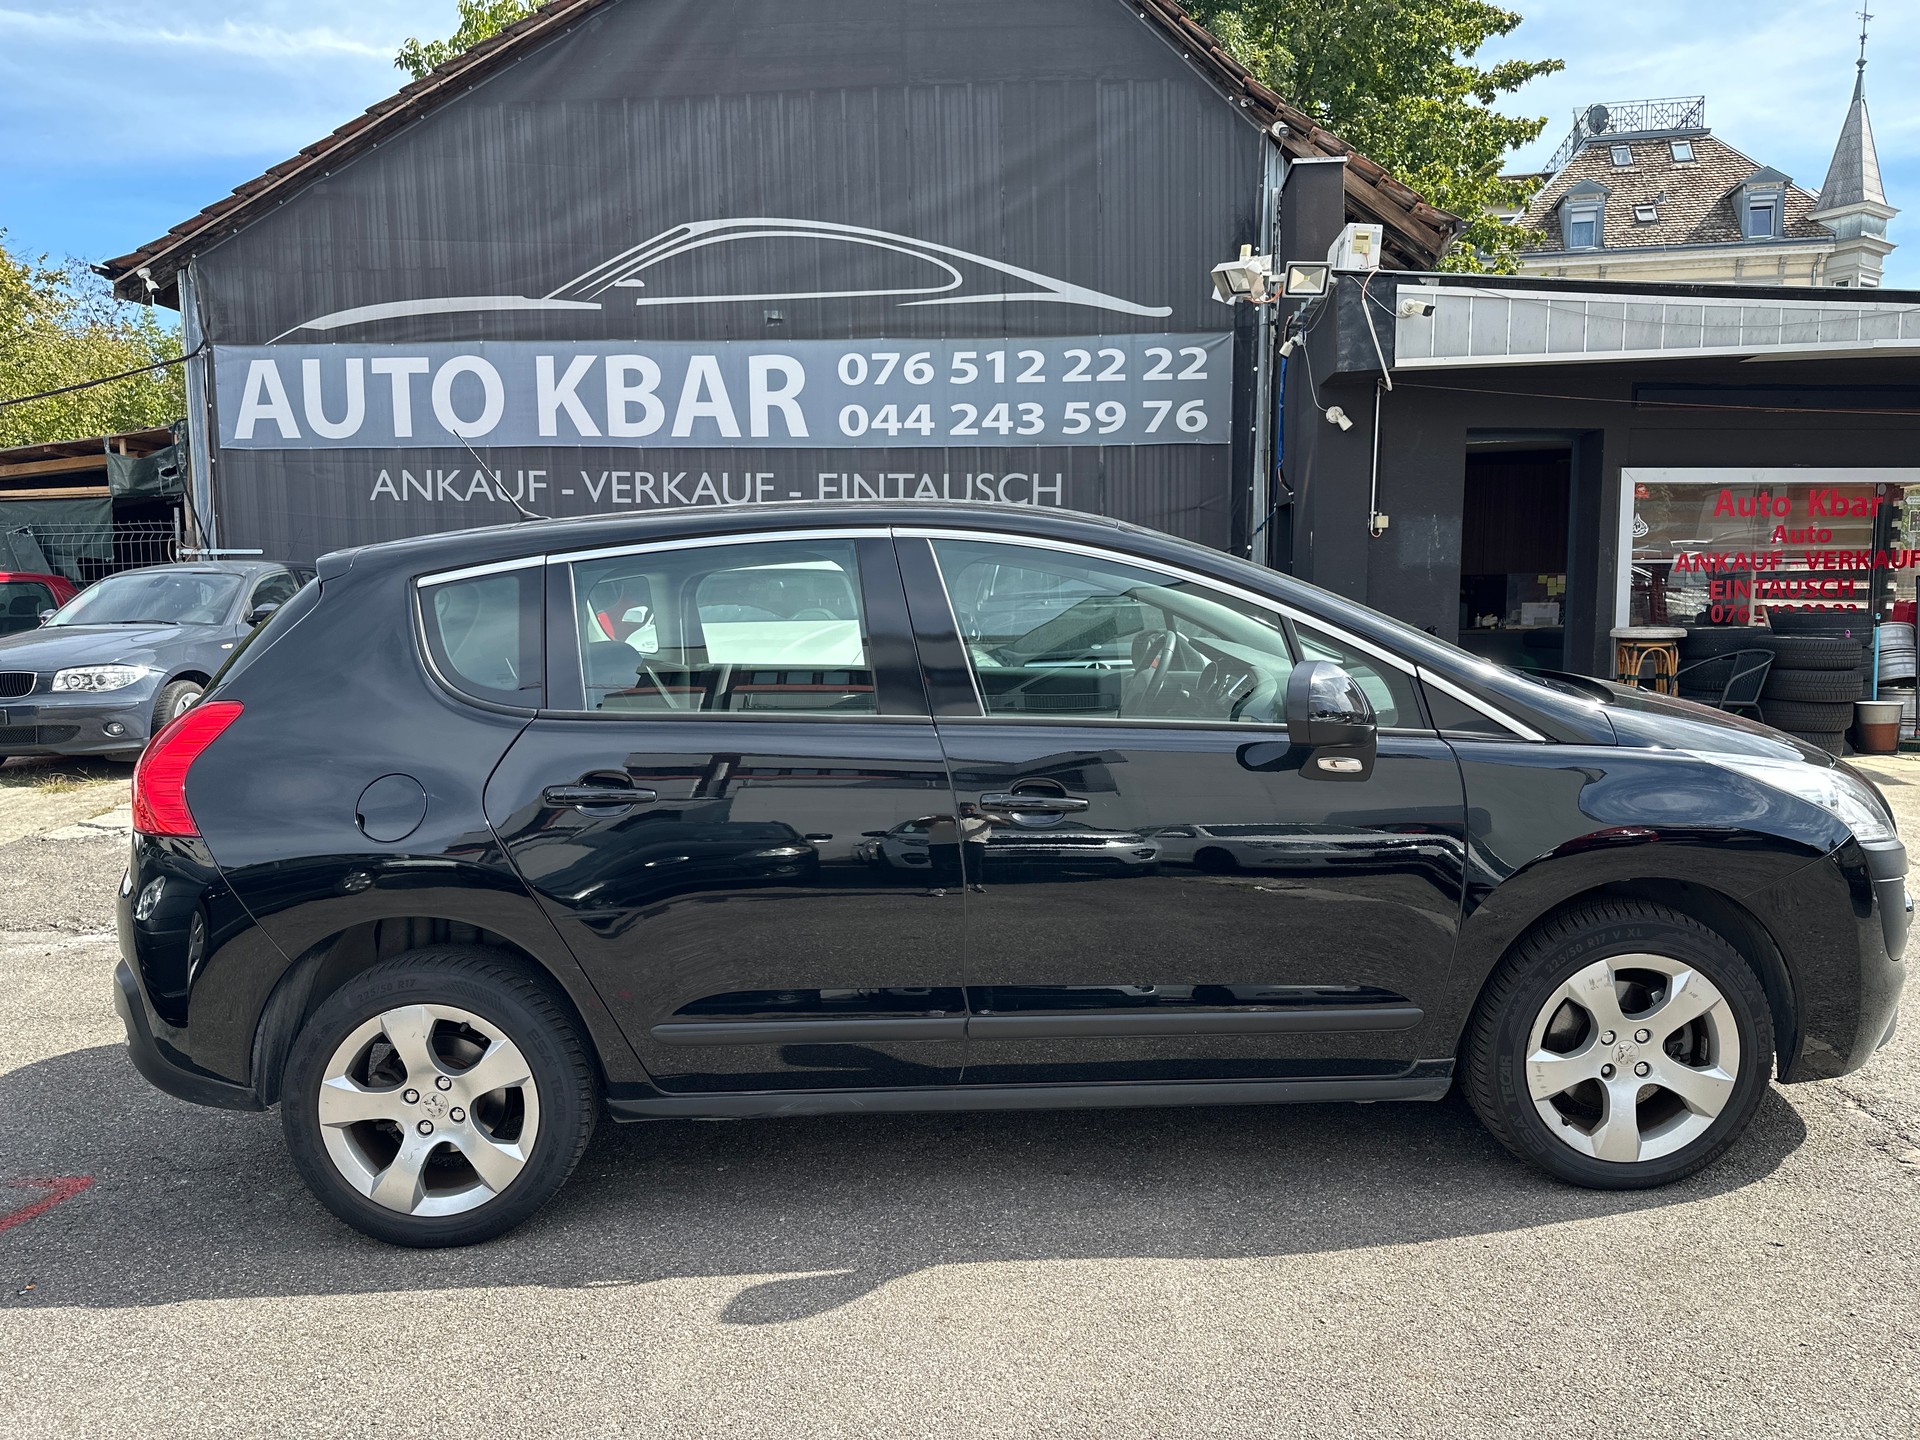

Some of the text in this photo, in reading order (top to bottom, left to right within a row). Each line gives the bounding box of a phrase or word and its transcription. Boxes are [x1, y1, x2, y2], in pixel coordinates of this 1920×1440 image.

[837, 346, 1208, 386] 076 512 22 22
[234, 354, 810, 440] AUTO KBAR
[838, 399, 1208, 437] 044 243 59 76
[369, 469, 547, 502] ANKAUF
[1713, 488, 1884, 517] Auto Kbar
[1771, 525, 1833, 544] Auto
[1673, 551, 1784, 573] ANKAUF
[1709, 578, 1855, 600] EINTAUSCH
[1711, 604, 1750, 623] 076
[1545, 928, 1643, 973] 225/50 R17 V XL
[357, 979, 416, 1002] 225/50 R17
[1754, 1016, 1770, 1064] TECAR
[1499, 1055, 1516, 1106] TECAR
